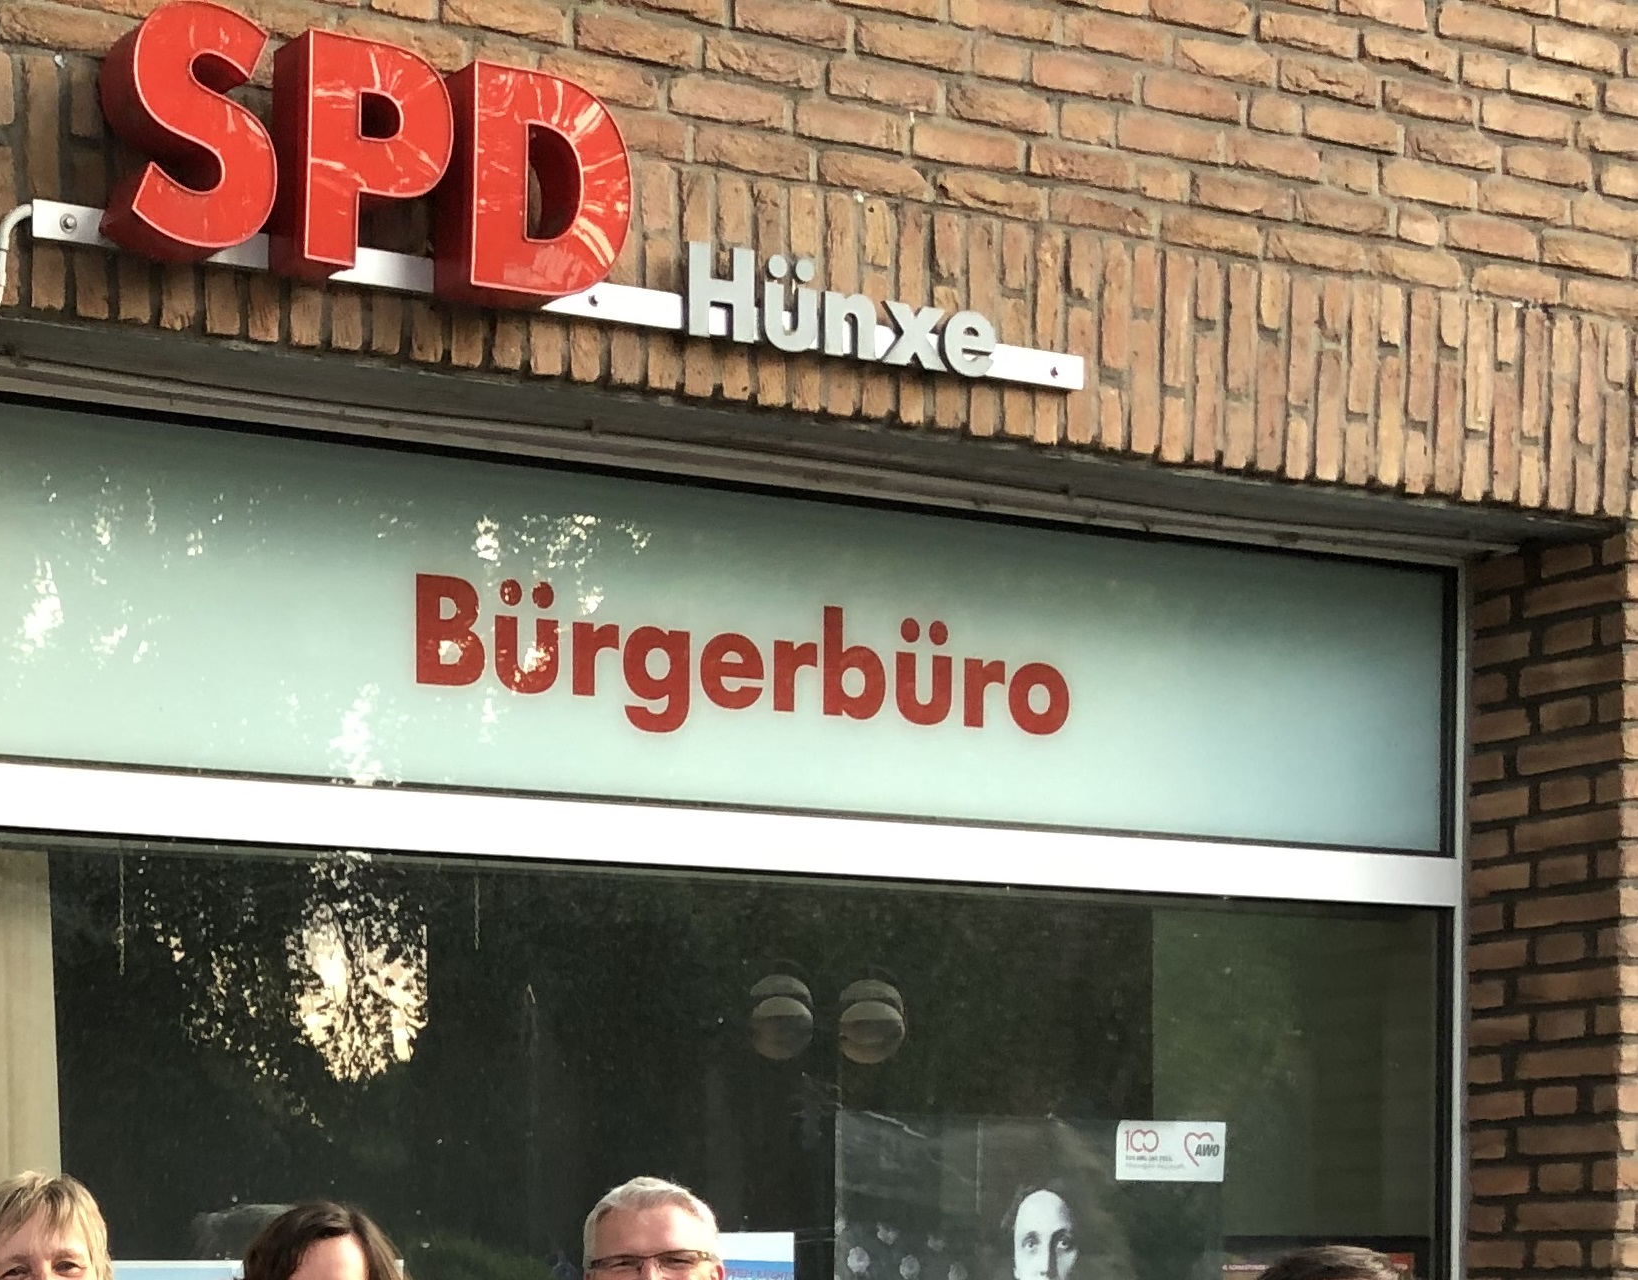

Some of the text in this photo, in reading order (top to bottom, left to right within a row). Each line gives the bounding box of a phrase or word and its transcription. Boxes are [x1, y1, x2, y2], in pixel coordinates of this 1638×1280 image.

[102, 0, 632, 307] SPD
[682, 240, 998, 378] Hünxe
[414, 572, 1071, 734] Bürgerbüro
[1125, 1129, 1159, 1153] 100
[1195, 1143, 1220, 1157] AWO
